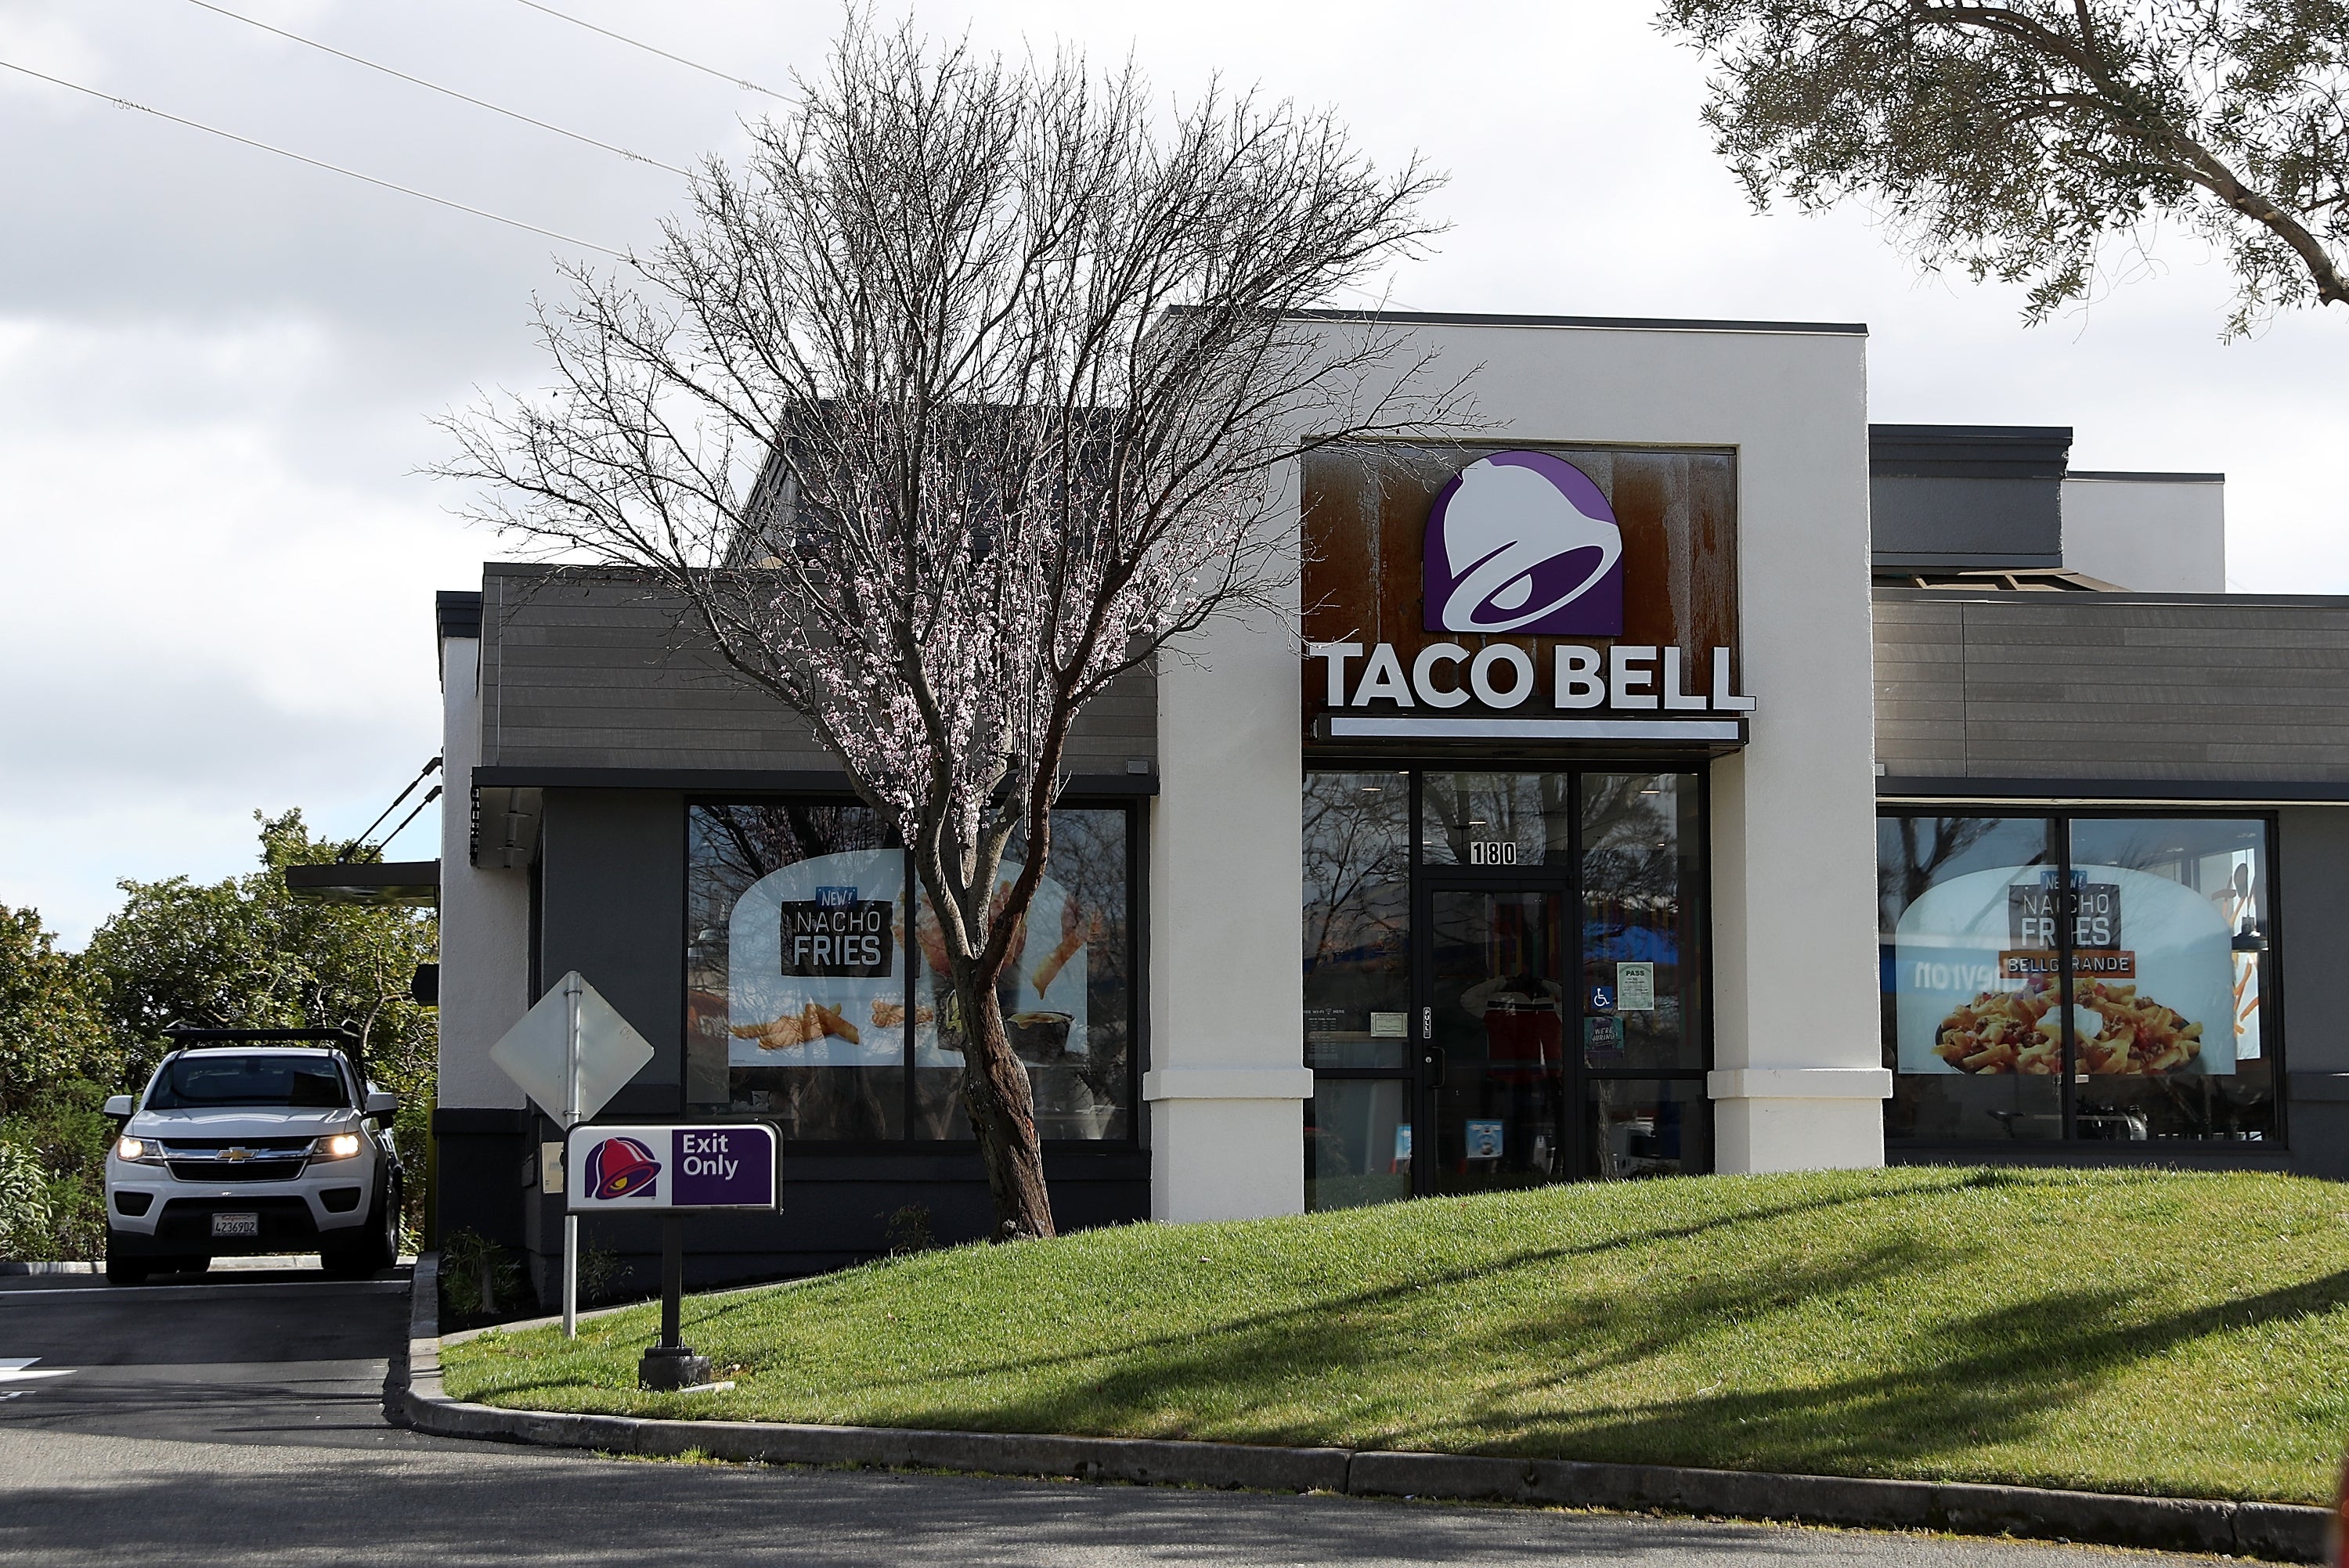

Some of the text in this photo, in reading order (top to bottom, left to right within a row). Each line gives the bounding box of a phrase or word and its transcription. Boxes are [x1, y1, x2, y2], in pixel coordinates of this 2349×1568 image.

[1309, 642, 1757, 712] TACO BELL
[1473, 843, 1515, 863] 180
[821, 889, 853, 907] NEW!
[797, 911, 881, 933] NACHO
[794, 935, 882, 966] FRIES
[683, 1133, 728, 1153] Exit
[683, 1154, 739, 1181] Only
